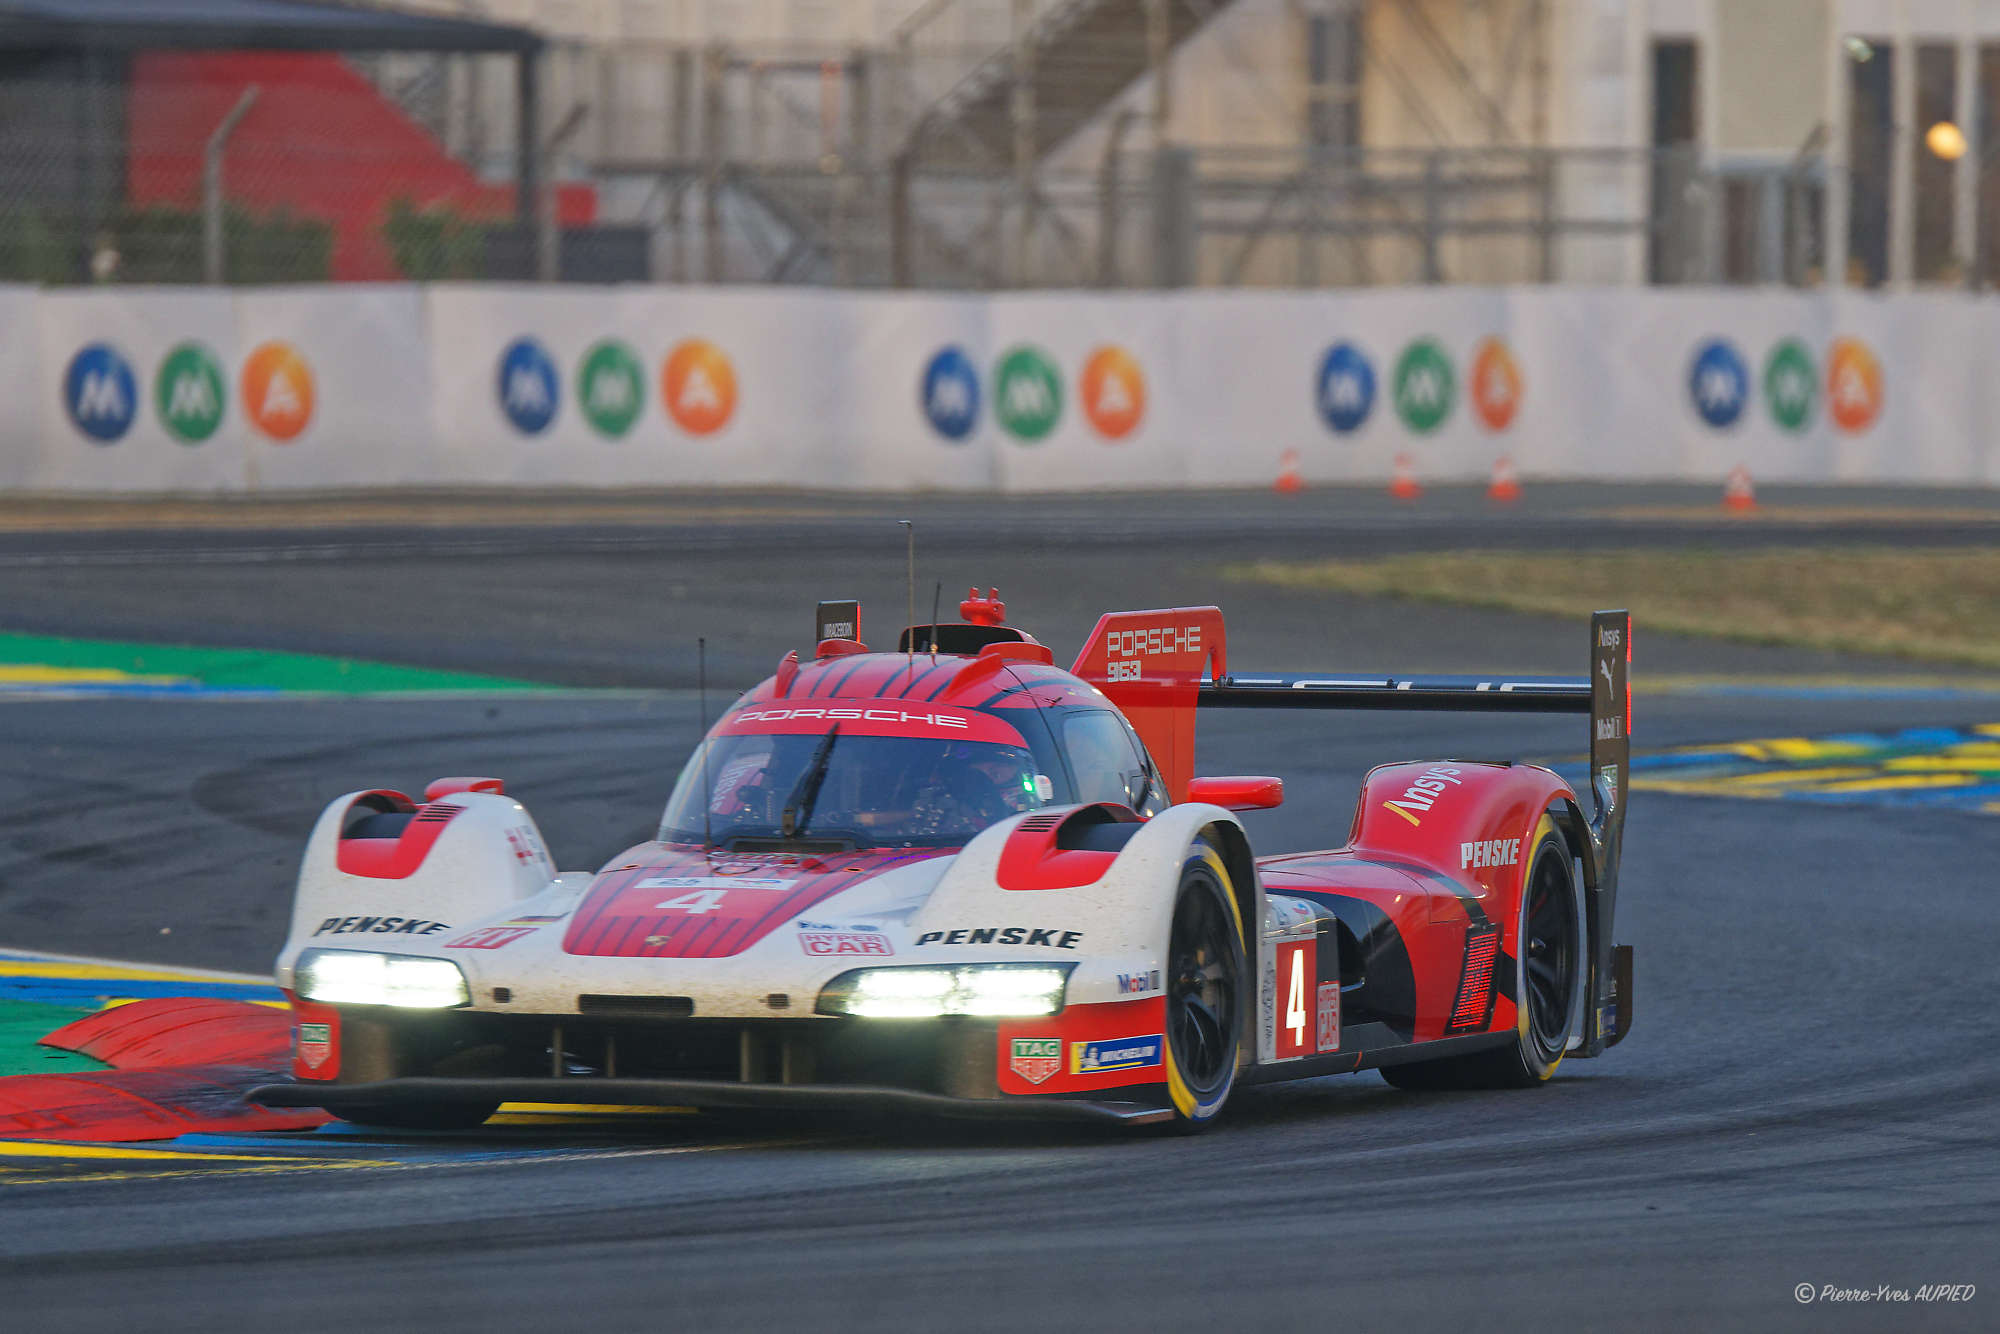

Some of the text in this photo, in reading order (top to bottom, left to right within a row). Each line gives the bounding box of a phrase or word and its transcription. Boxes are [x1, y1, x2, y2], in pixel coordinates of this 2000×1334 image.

[1107, 627, 1200, 658] PORSCHE
[1597, 624, 1620, 651] Ansys
[1107, 660, 1141, 683] 963
[734, 708, 968, 729] PORSCHE
[1383, 767, 1463, 827] Ansys
[1461, 838, 1520, 870] PENSKE
[655, 889, 728, 914] 4
[312, 916, 450, 937] PENSKE
[805, 933, 882, 943] HYPER
[914, 926, 1084, 950] PENSKE
[810, 941, 886, 954] CAR
[1116, 971, 1151, 994] Mobil
[1286, 949, 1306, 1047] 4
[1319, 1010, 1338, 1048] CAR
[1015, 1041, 1058, 1056] TAG
